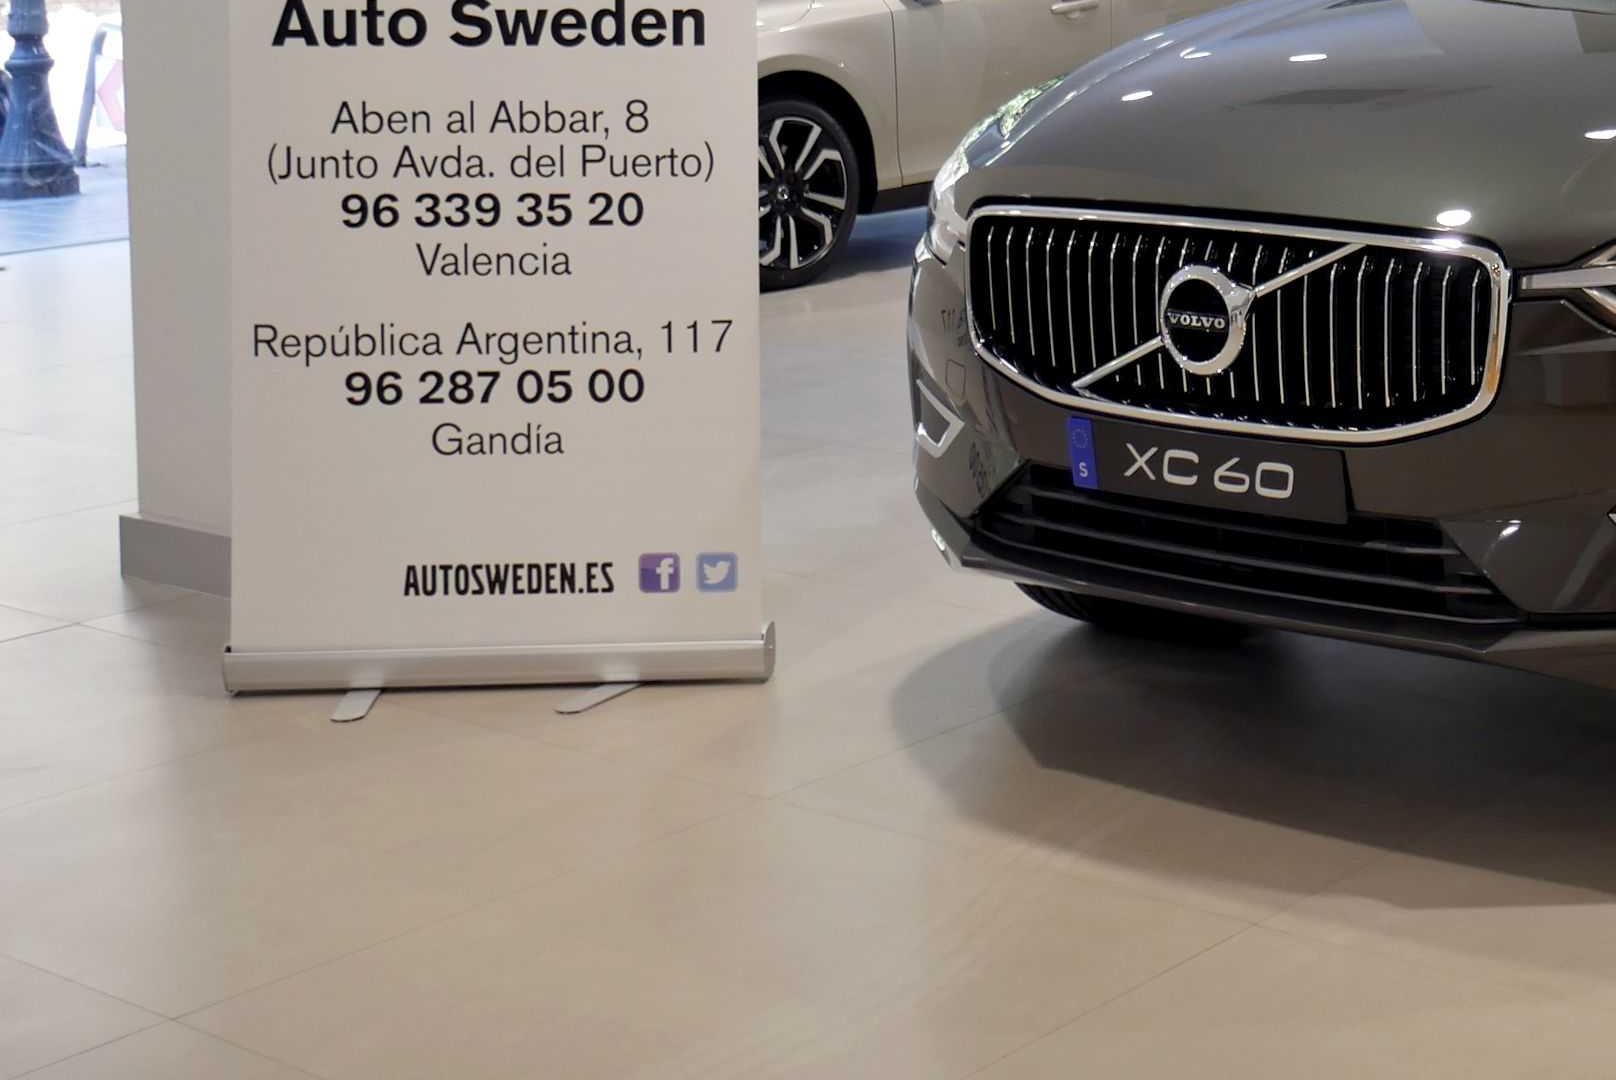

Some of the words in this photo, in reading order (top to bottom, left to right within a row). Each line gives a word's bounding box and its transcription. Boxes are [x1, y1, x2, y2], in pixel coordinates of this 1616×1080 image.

[331, 101, 431, 134] Aben
[446, 100, 475, 134] al
[489, 100, 609, 139] Abbar,
[625, 99, 649, 134] 8
[267, 144, 379, 184] (Junto
[393, 145, 495, 179] Avda.
[510, 145, 565, 179] del
[581, 142, 714, 182] Puerto)
[341, 194, 399, 228] 96
[414, 193, 501, 227] 339
[516, 193, 573, 227] 35
[588, 192, 644, 227] 20
[416, 243, 572, 277] Valencia
[1167, 313, 1225, 330] VOLVO
[253, 323, 443, 367] República
[456, 321, 643, 366] Argentina,
[661, 320, 733, 354] 117
[345, 371, 403, 406] 96
[418, 370, 501, 404] 287
[516, 370, 573, 404] 05
[588, 369, 645, 403] 00
[431, 423, 564, 456] Gandía
[1078, 462, 1089, 478] S
[1123, 442, 1200, 486] XC
[1213, 456, 1295, 500] 60
[404, 562, 615, 596] AUTOSWEDEN.ES
